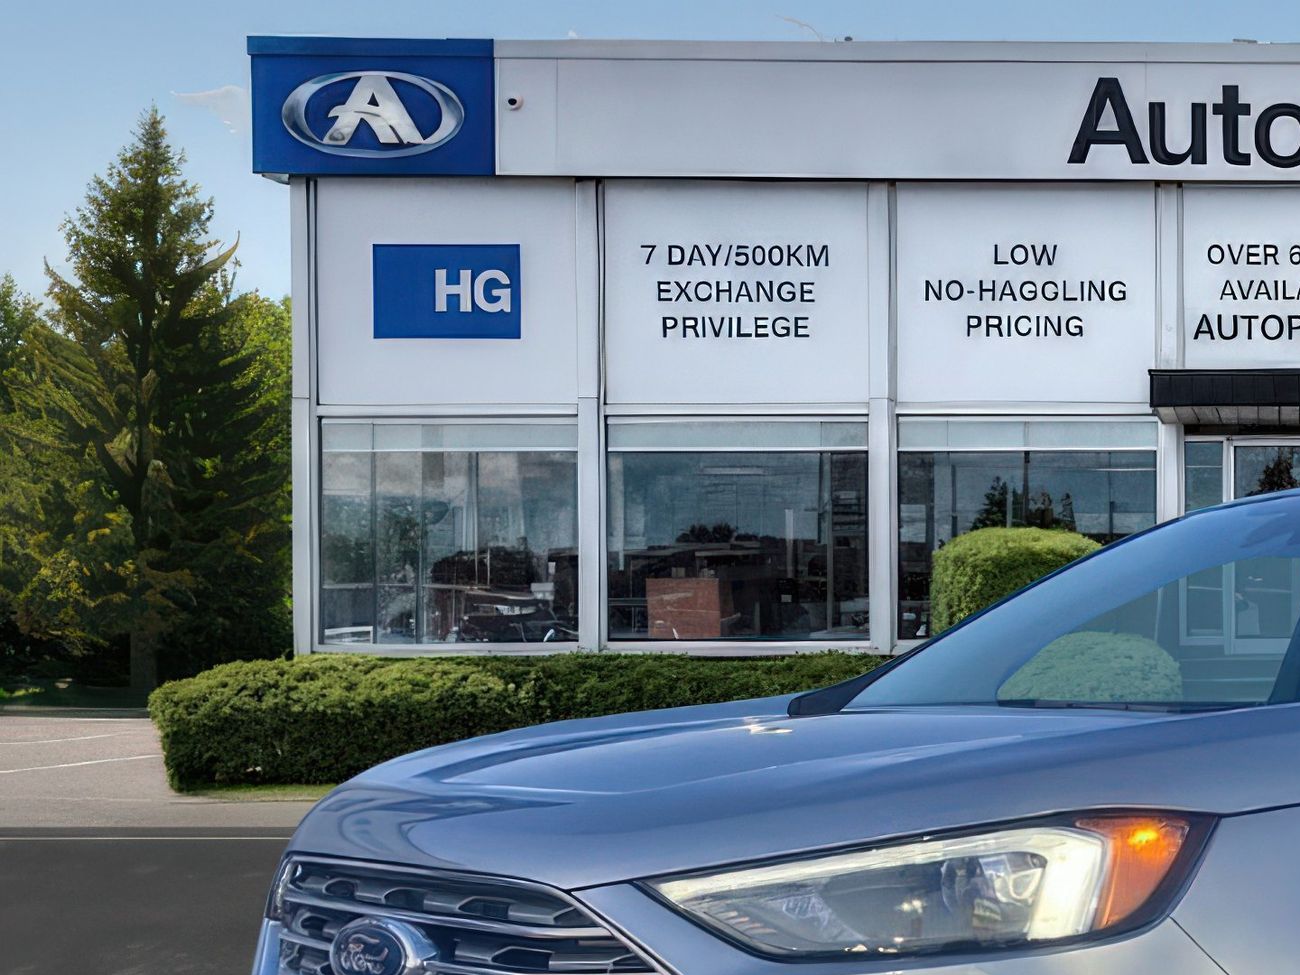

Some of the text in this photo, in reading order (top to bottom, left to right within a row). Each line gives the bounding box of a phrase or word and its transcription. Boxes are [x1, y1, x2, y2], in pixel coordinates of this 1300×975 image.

[640, 243, 830, 268] 7 DAY/500KM
[993, 243, 1058, 267] LOW
[1207, 243, 1280, 266] OVER
[434, 268, 512, 313] HG
[656, 280, 816, 303] EXCHANGE
[924, 279, 1127, 302] NO-HAGGLING
[661, 315, 810, 339] PRIVILEGE
[966, 314, 1084, 338] PRICING
